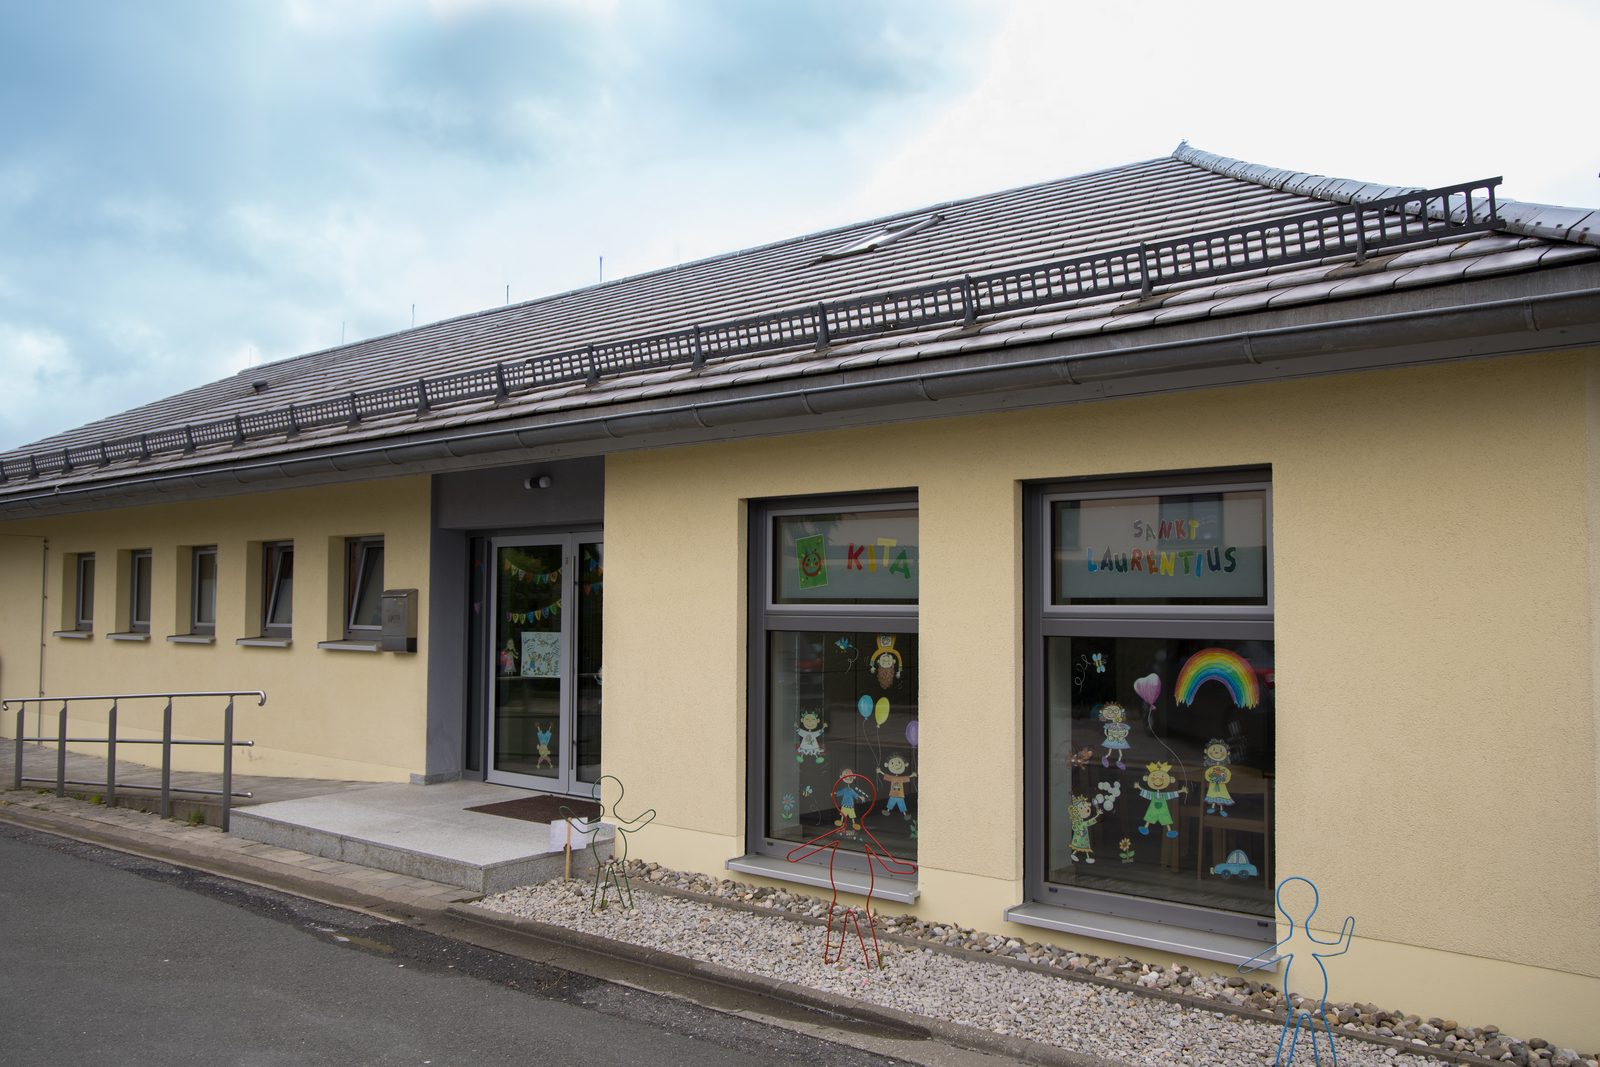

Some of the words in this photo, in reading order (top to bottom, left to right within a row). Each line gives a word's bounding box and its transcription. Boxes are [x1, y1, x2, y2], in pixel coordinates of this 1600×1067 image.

[1133, 519, 1199, 541] SANKT
[847, 537, 911, 579] KITA
[1087, 545, 1237, 577] LAURENTIUS
